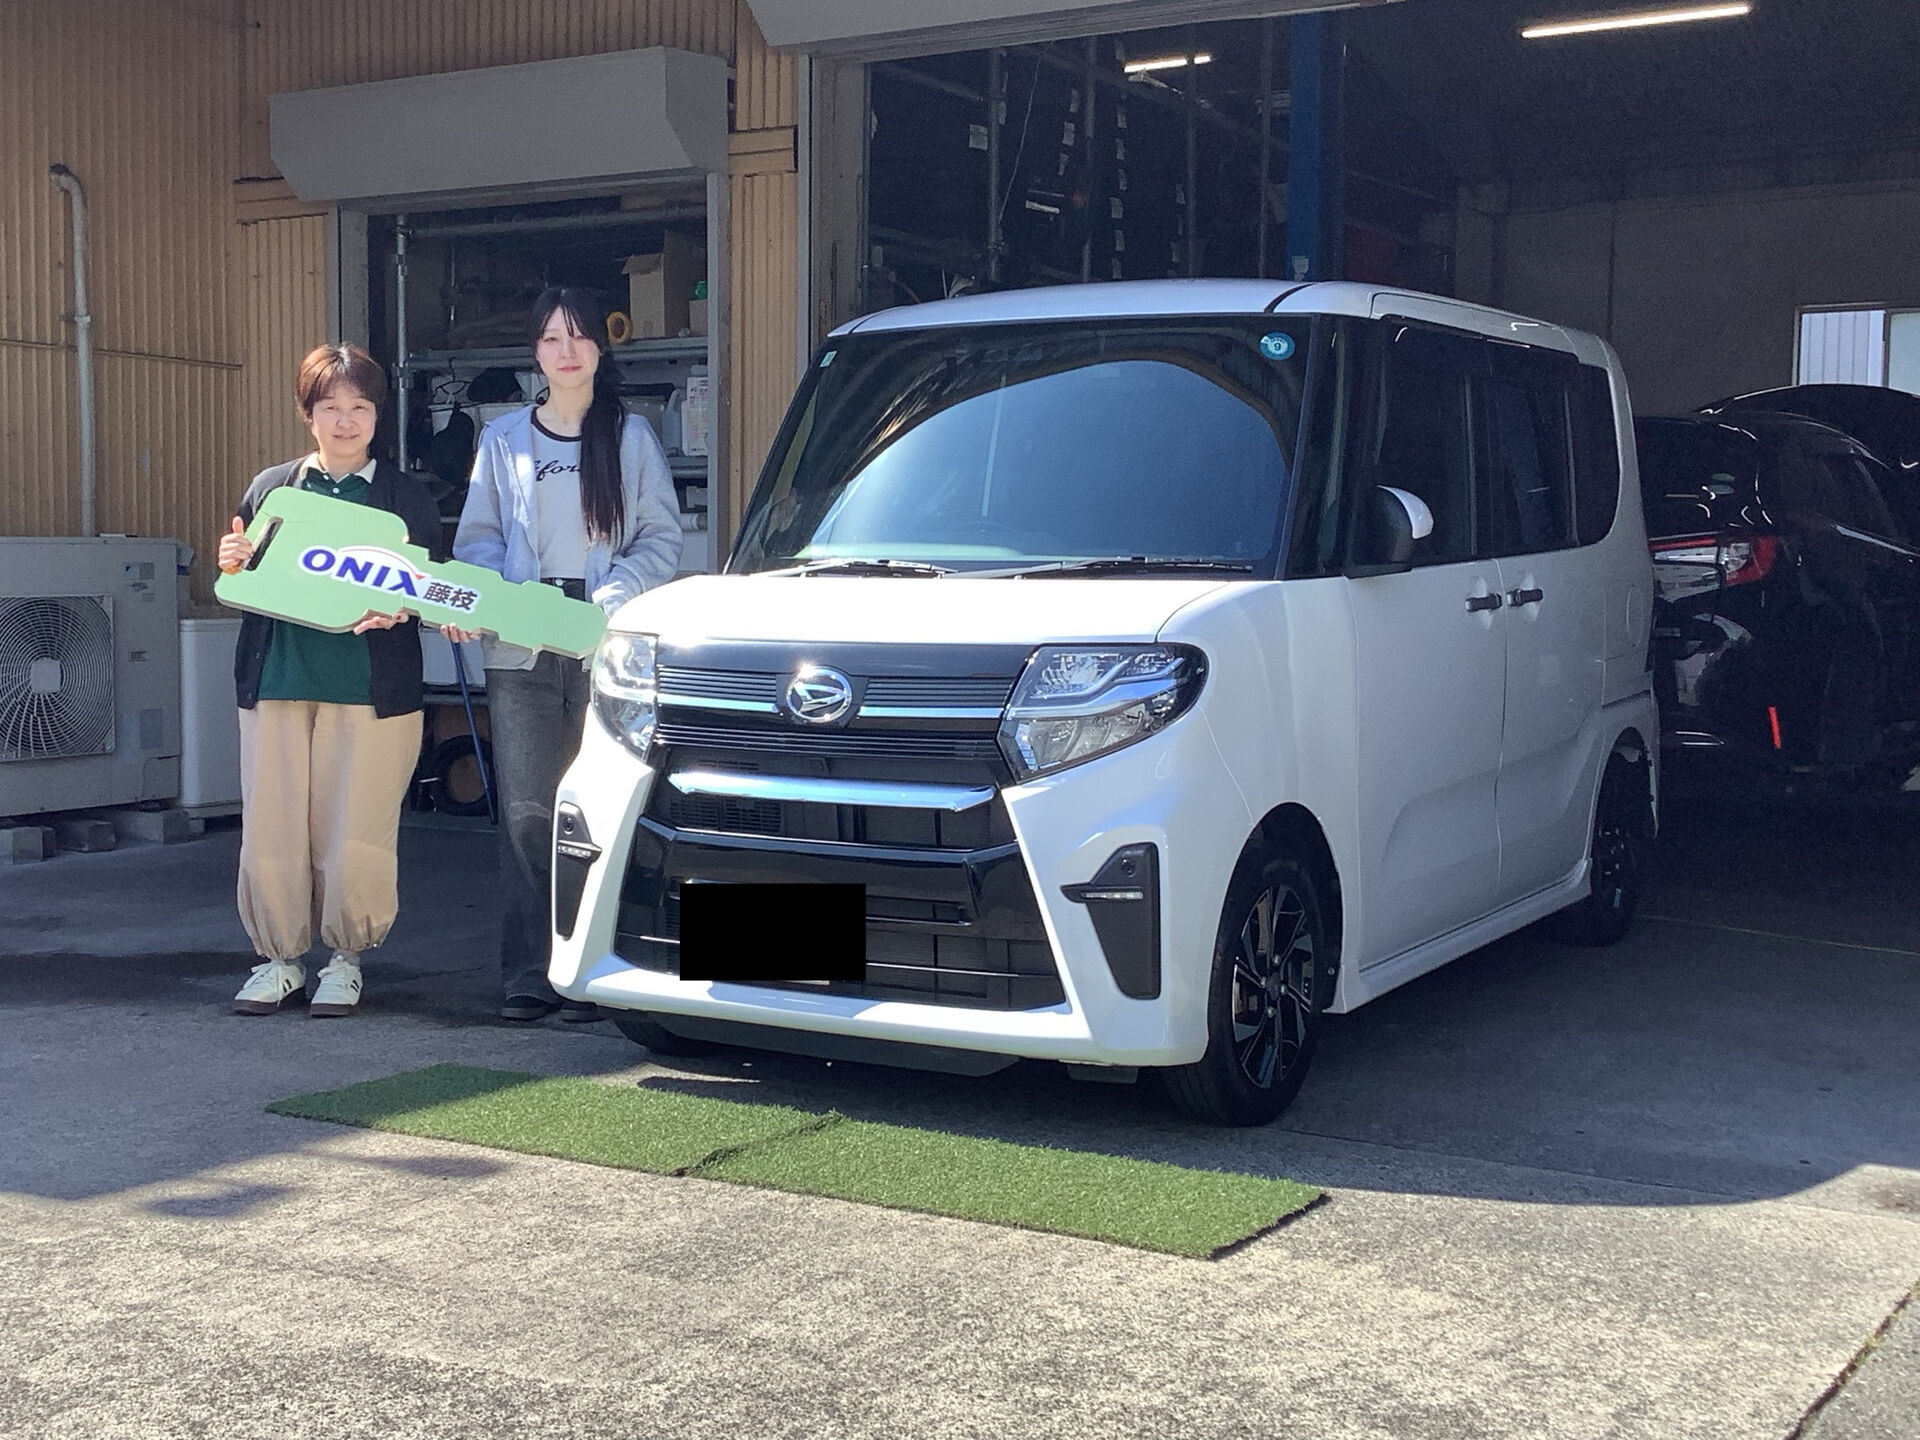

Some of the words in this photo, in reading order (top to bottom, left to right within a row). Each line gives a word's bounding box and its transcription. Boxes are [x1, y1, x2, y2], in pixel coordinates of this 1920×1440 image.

[1274, 342, 1282, 351] 9
[534, 460, 580, 481] for
[302, 549, 417, 597] ONIX
[423, 582, 478, 611] 藤枝
